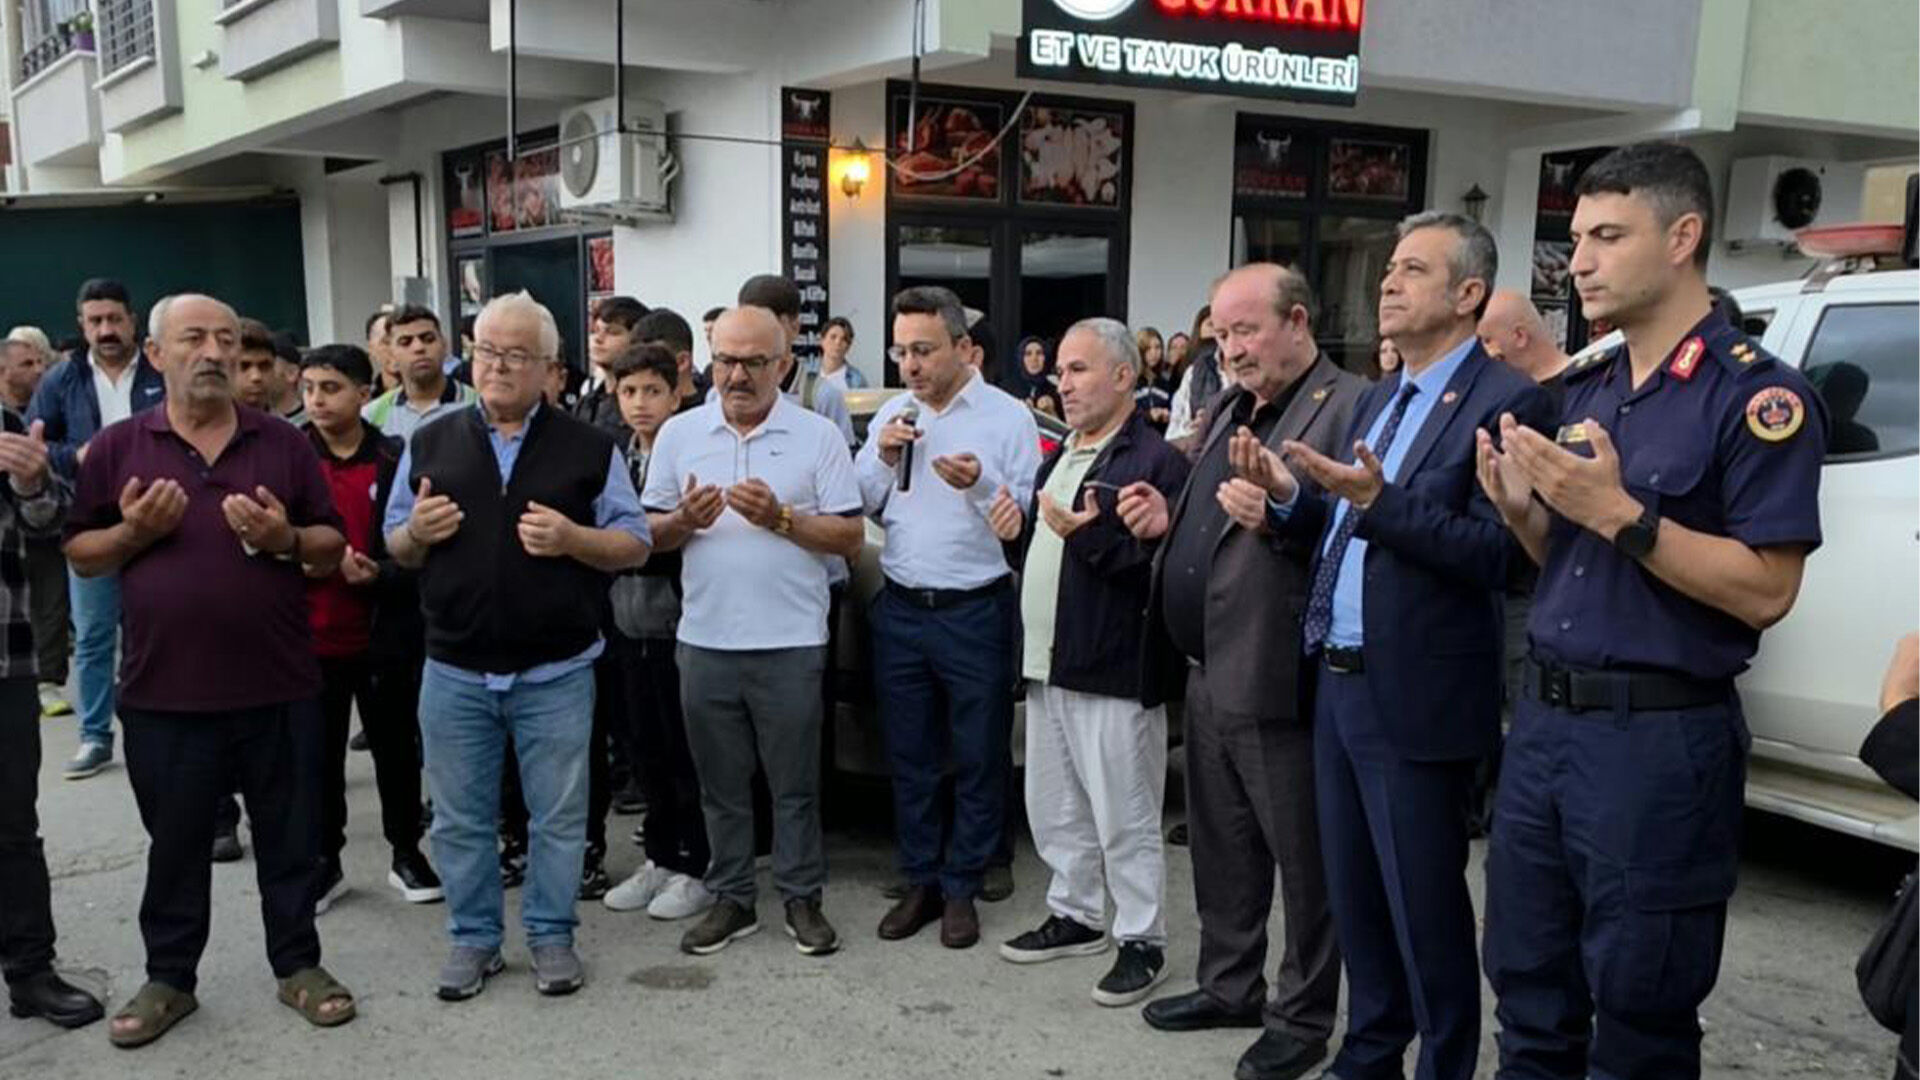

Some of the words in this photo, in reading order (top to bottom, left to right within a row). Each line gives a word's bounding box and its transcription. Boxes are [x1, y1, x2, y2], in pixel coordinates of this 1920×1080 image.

[1033, 31, 1072, 64] ET
[1079, 36, 1119, 69] VE
[1125, 41, 1219, 78] TAVUK
[1222, 44, 1358, 91] ÜRÜNLERİ
